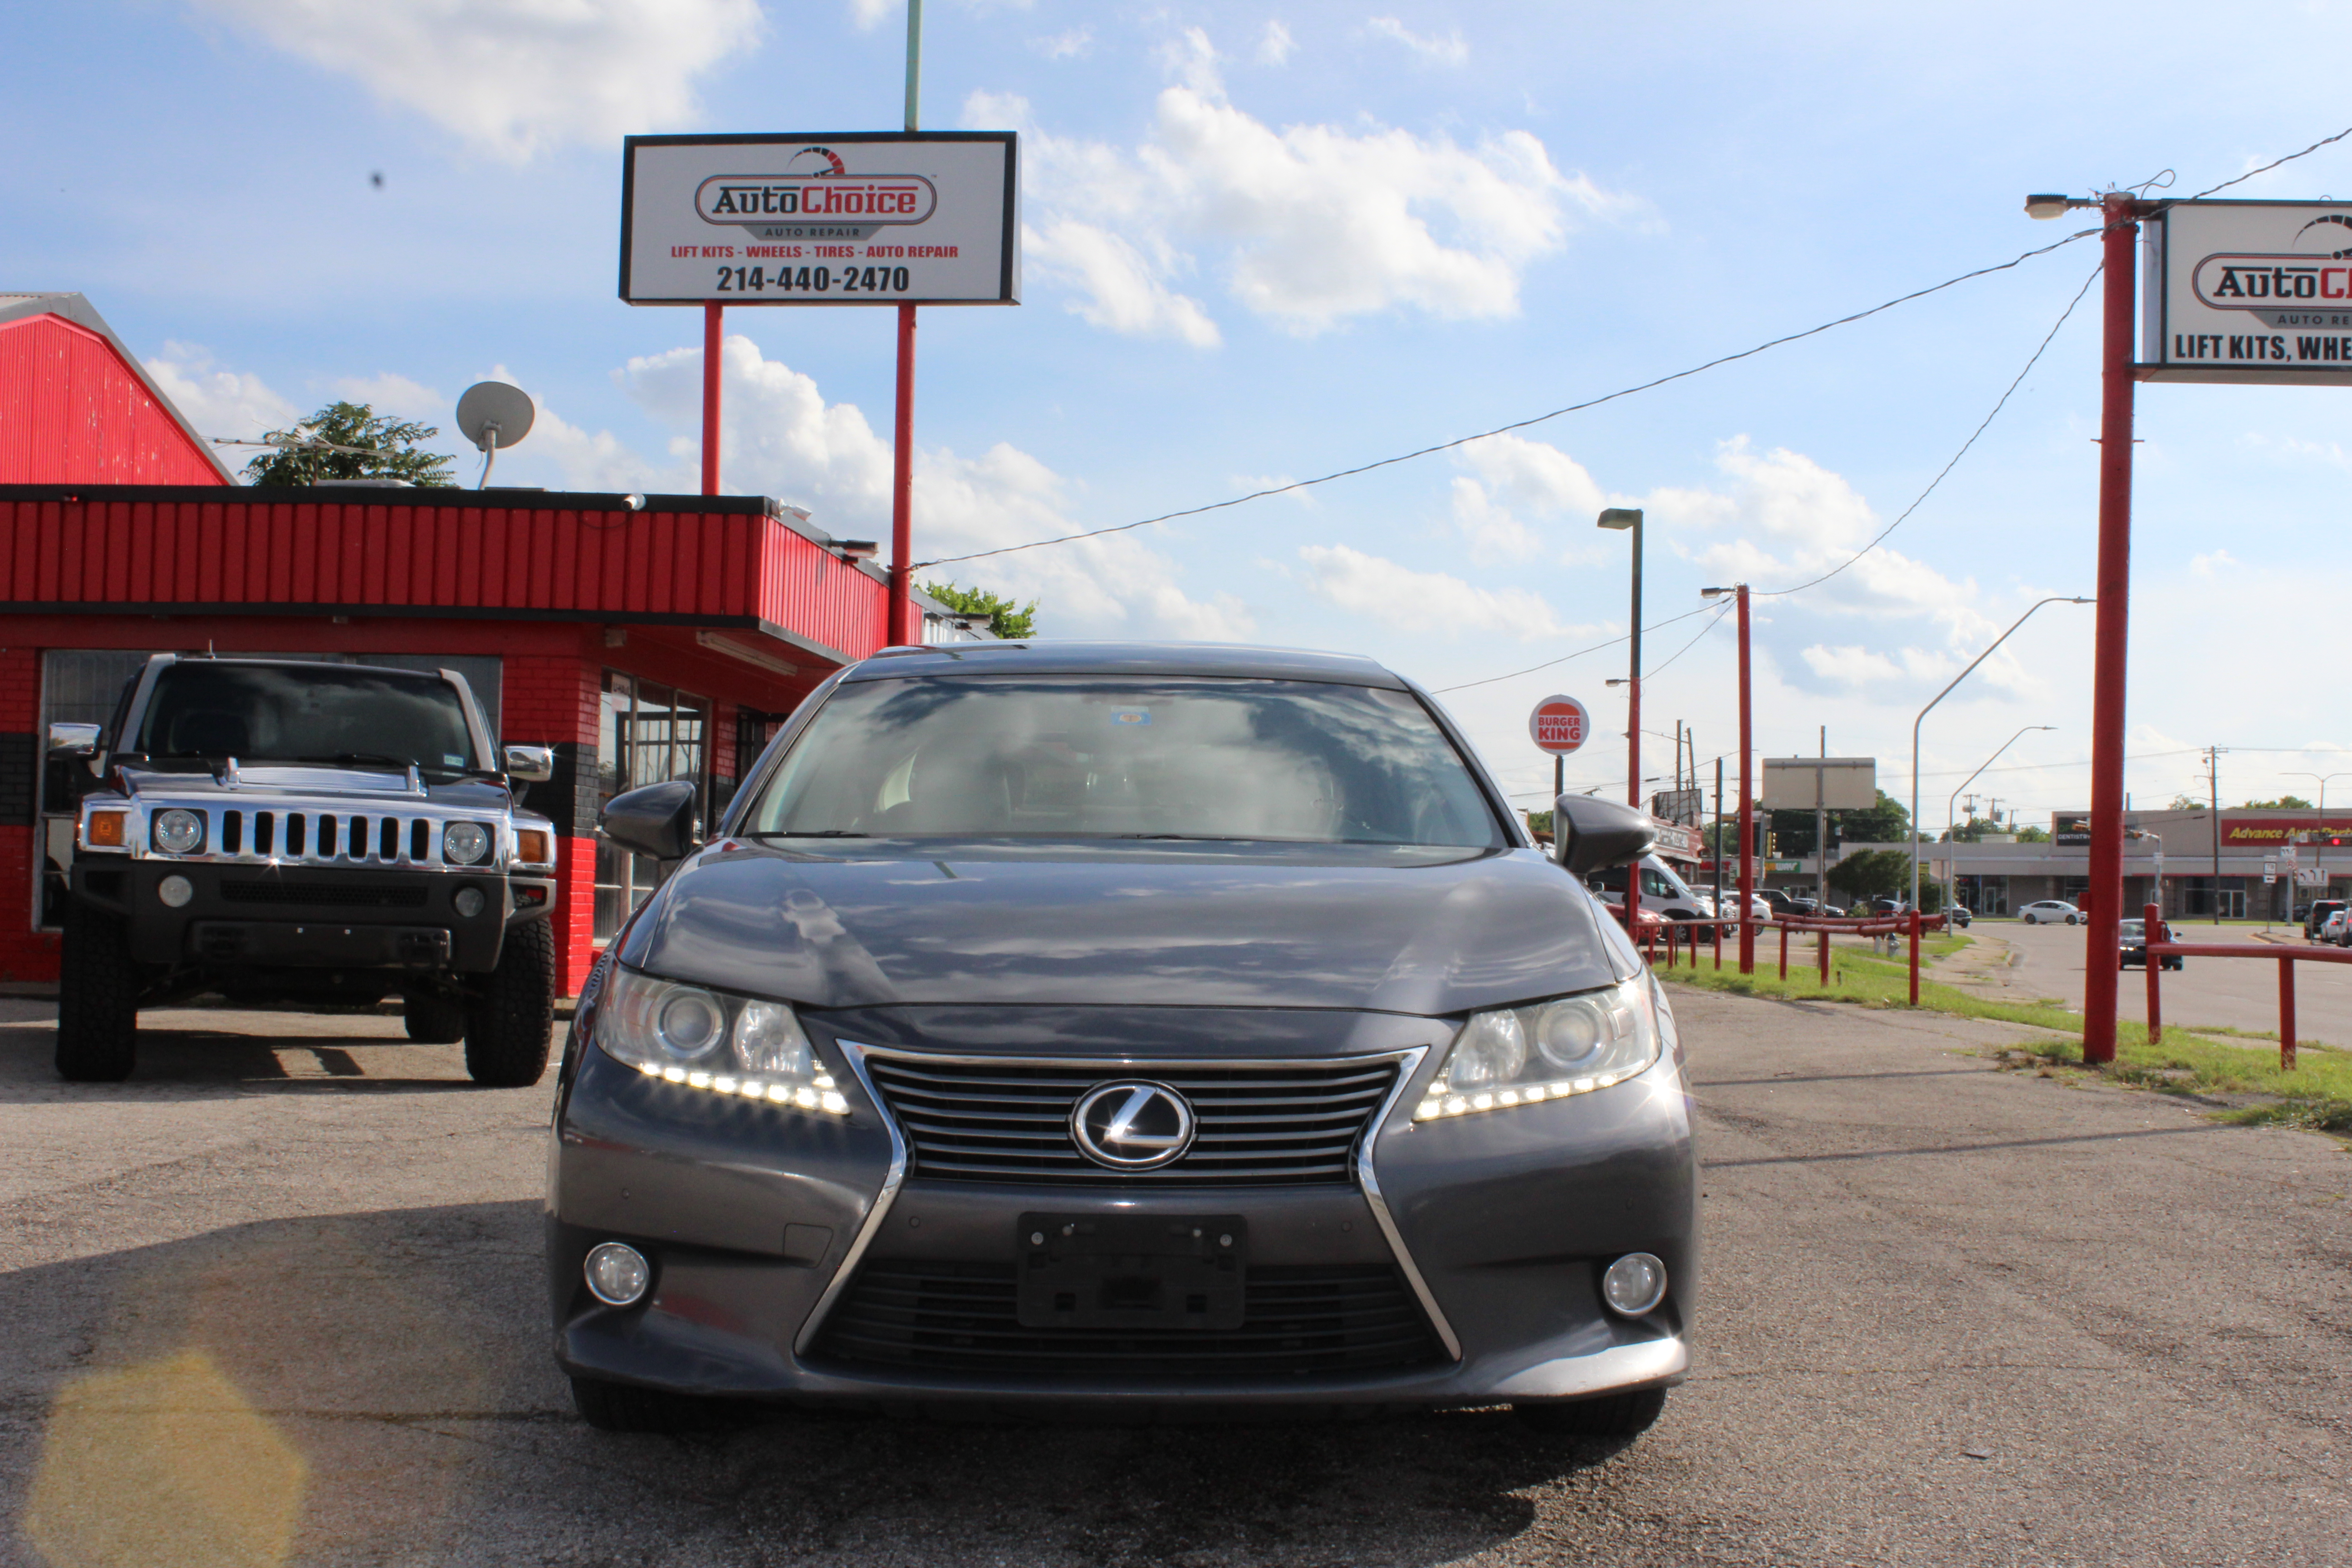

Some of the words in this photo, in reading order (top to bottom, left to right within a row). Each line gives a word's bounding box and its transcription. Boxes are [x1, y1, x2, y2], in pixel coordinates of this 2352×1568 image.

[712, 185, 918, 214] AutoChoice
[765, 228, 803, 236] AUTO
[810, 228, 859, 236] REPAIR
[671, 246, 699, 258] LIFT
[702, 246, 734, 258] KITS
[746, 246, 802, 258] WHEELS
[814, 246, 854, 258] TIRES
[866, 246, 904, 258] AUTO
[908, 246, 958, 258] REPAIR
[717, 266, 909, 292] 214-440-2470
[2278, 315, 2323, 325] AUTO
[2175, 334, 2223, 358] LIFT
[2229, 335, 2292, 362] KITS,
[2297, 337, 2352, 361] WHE
[1539, 717, 1580, 726] BURGER
[1539, 727, 1581, 740] KING
[2229, 827, 2283, 838] Advance
